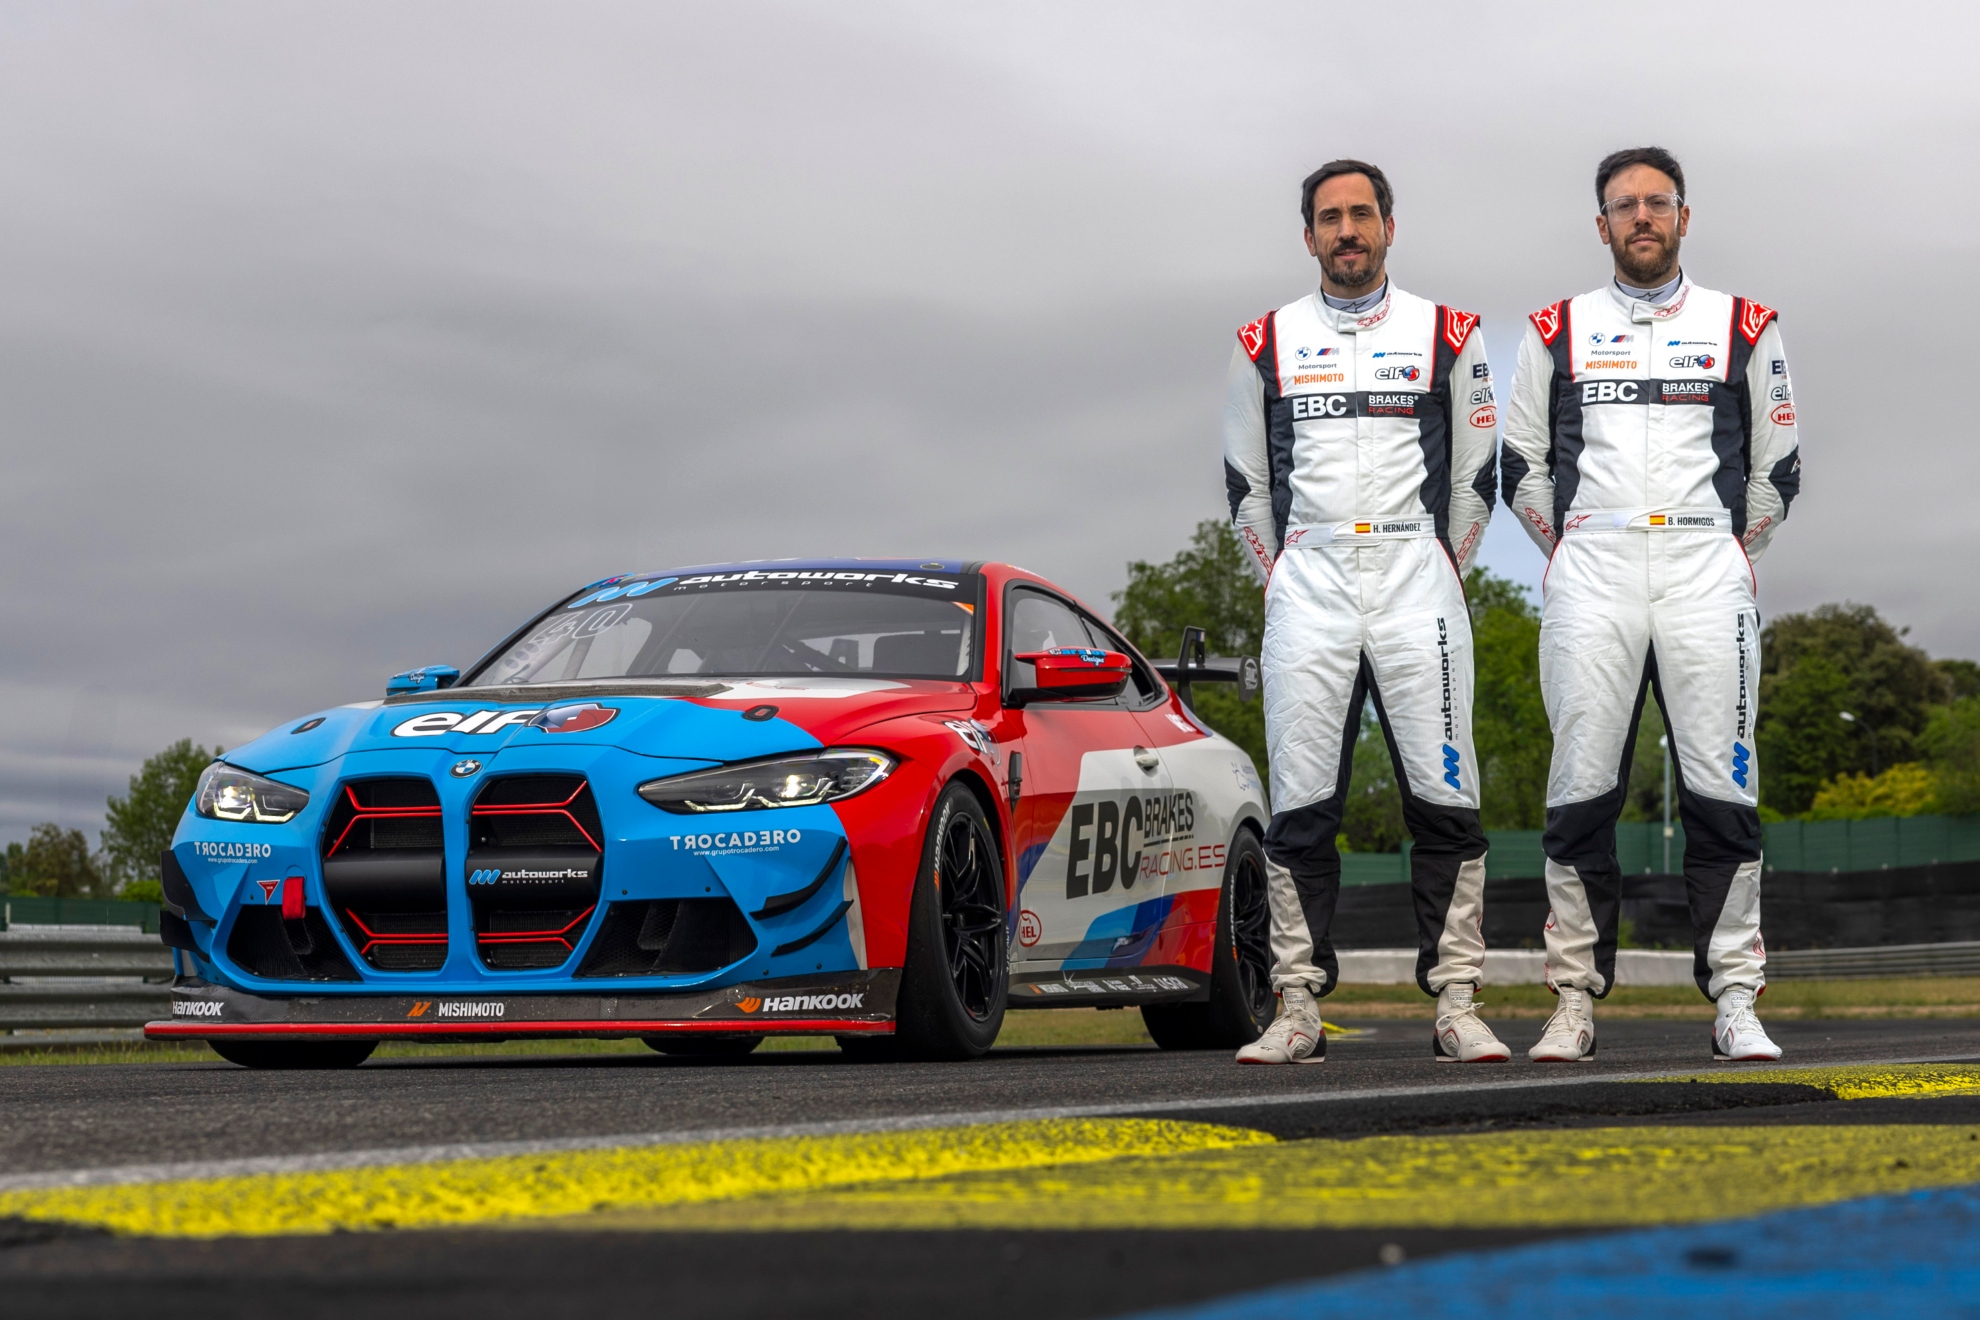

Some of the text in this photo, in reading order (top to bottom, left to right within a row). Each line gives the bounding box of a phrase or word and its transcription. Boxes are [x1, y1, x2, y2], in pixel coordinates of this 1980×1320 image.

[1585, 360, 1637, 370] MISHIMOTO
[1669, 355, 1700, 368] elf
[1294, 373, 1344, 385] MISHIMOTO
[1375, 366, 1404, 380] elf
[1582, 381, 1638, 404] EBC
[1662, 394, 1709, 403] RACING
[1292, 394, 1347, 419] EBC
[1368, 406, 1414, 415] RACING
[1373, 521, 1421, 533] H. HERNÁNDEZ
[1668, 516, 1715, 527] B. HORMIGOS
[674, 580, 873, 591] motorsport
[679, 570, 960, 589] autoworks
[1437, 617, 1452, 741] autoworks
[1736, 613, 1746, 739] autoworks
[390, 710, 541, 737] elf
[693, 845, 779, 856] www.grupotrocadero.com
[1066, 791, 1195, 900] EBC BRAKES
[1139, 844, 1225, 881] RACING.ES
[502, 869, 588, 879] autoworks
[438, 1002, 504, 1017] MISHIMOTO
